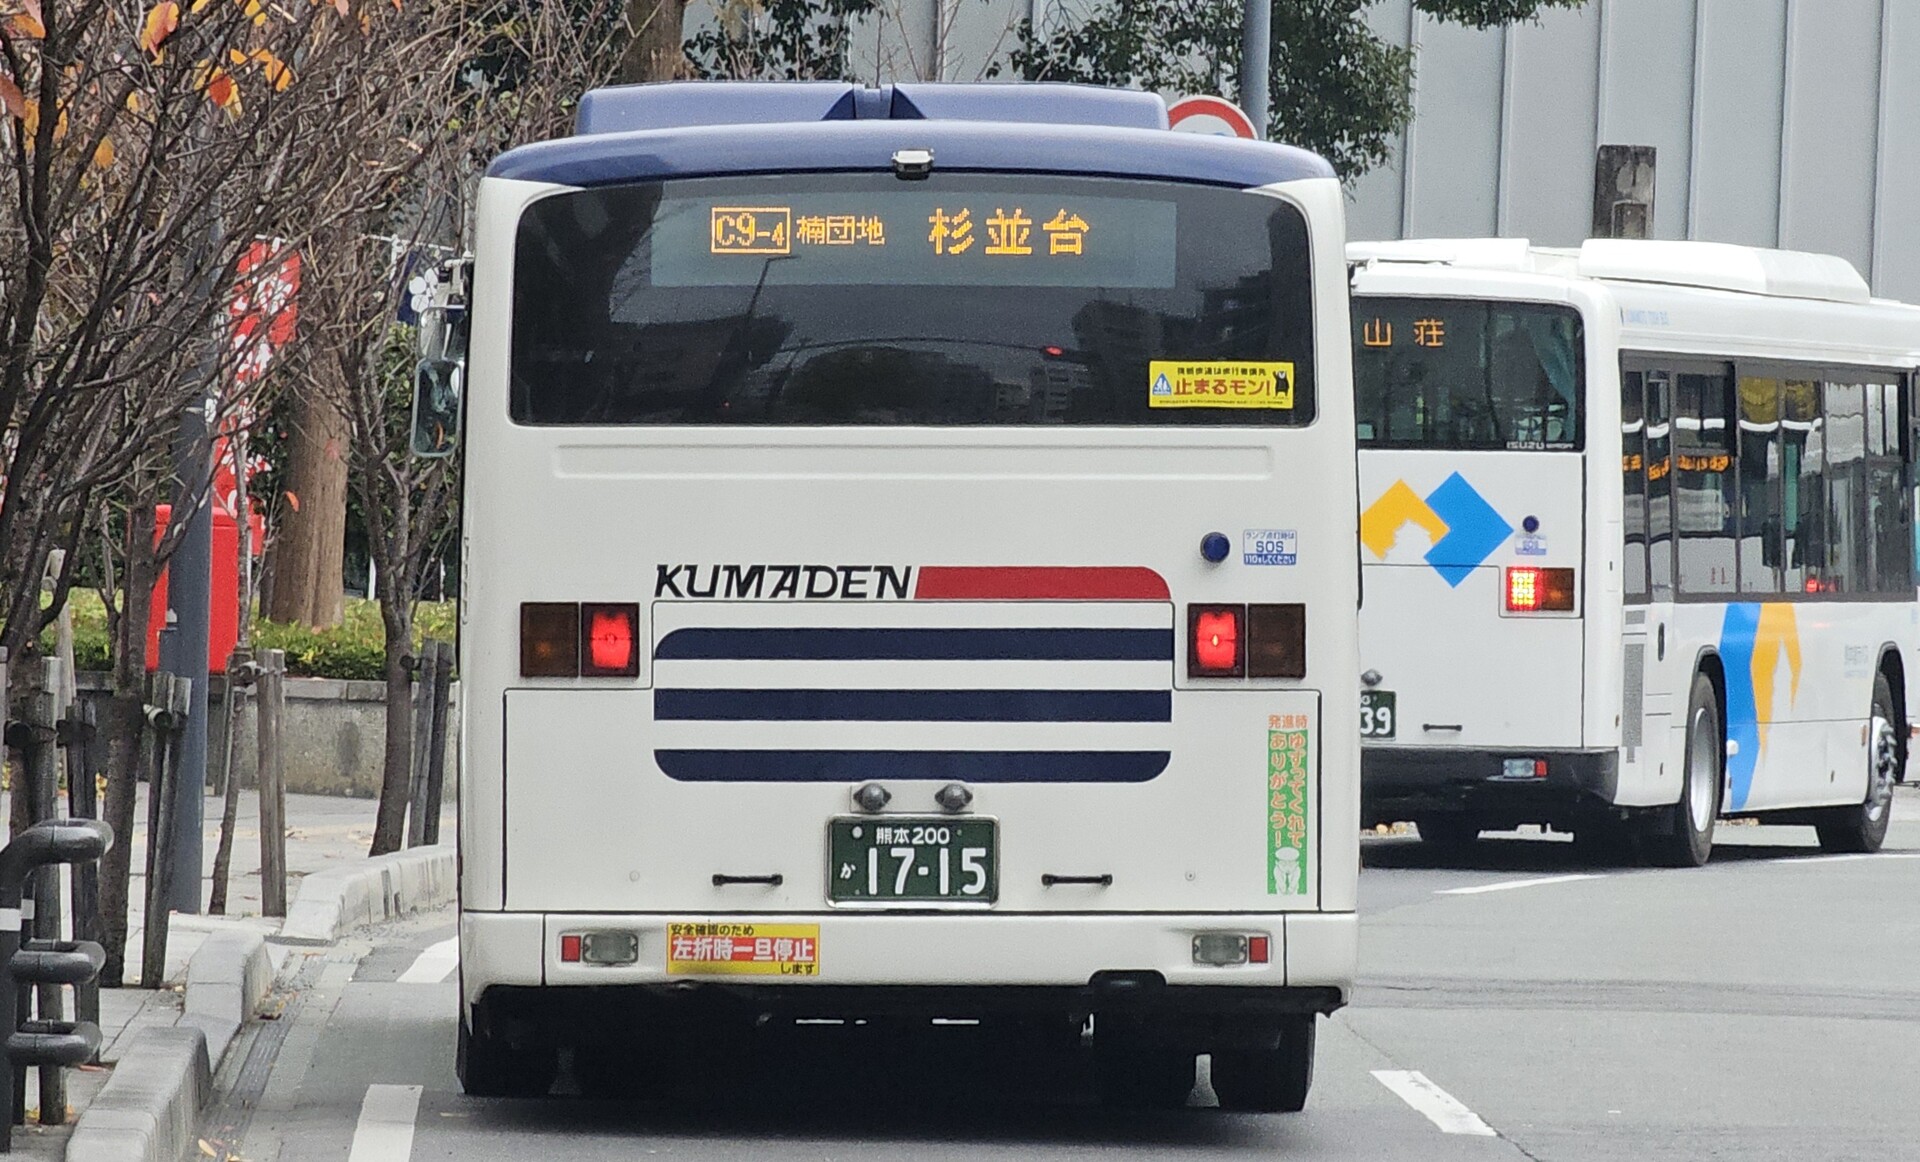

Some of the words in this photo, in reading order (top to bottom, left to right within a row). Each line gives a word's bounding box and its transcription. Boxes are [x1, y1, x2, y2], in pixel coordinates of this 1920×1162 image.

[717, 212, 785, 245] C9-4
[796, 215, 885, 245] 楠団地
[929, 208, 1090, 254] 杉並台
[1363, 318, 1445, 347] 山荘
[1174, 378, 1271, 396] 止まるモン!
[1255, 540, 1284, 553] SOS
[654, 564, 912, 599] KUMADEN
[1270, 733, 1288, 848] ありがとう!
[1288, 732, 1306, 848] ゆずってくれて
[840, 862, 856, 879] か
[868, 847, 987, 895] 17-15
[671, 924, 754, 936] 安全確認のため
[672, 937, 814, 961] 左折時一旦停止
[780, 963, 815, 975] します
